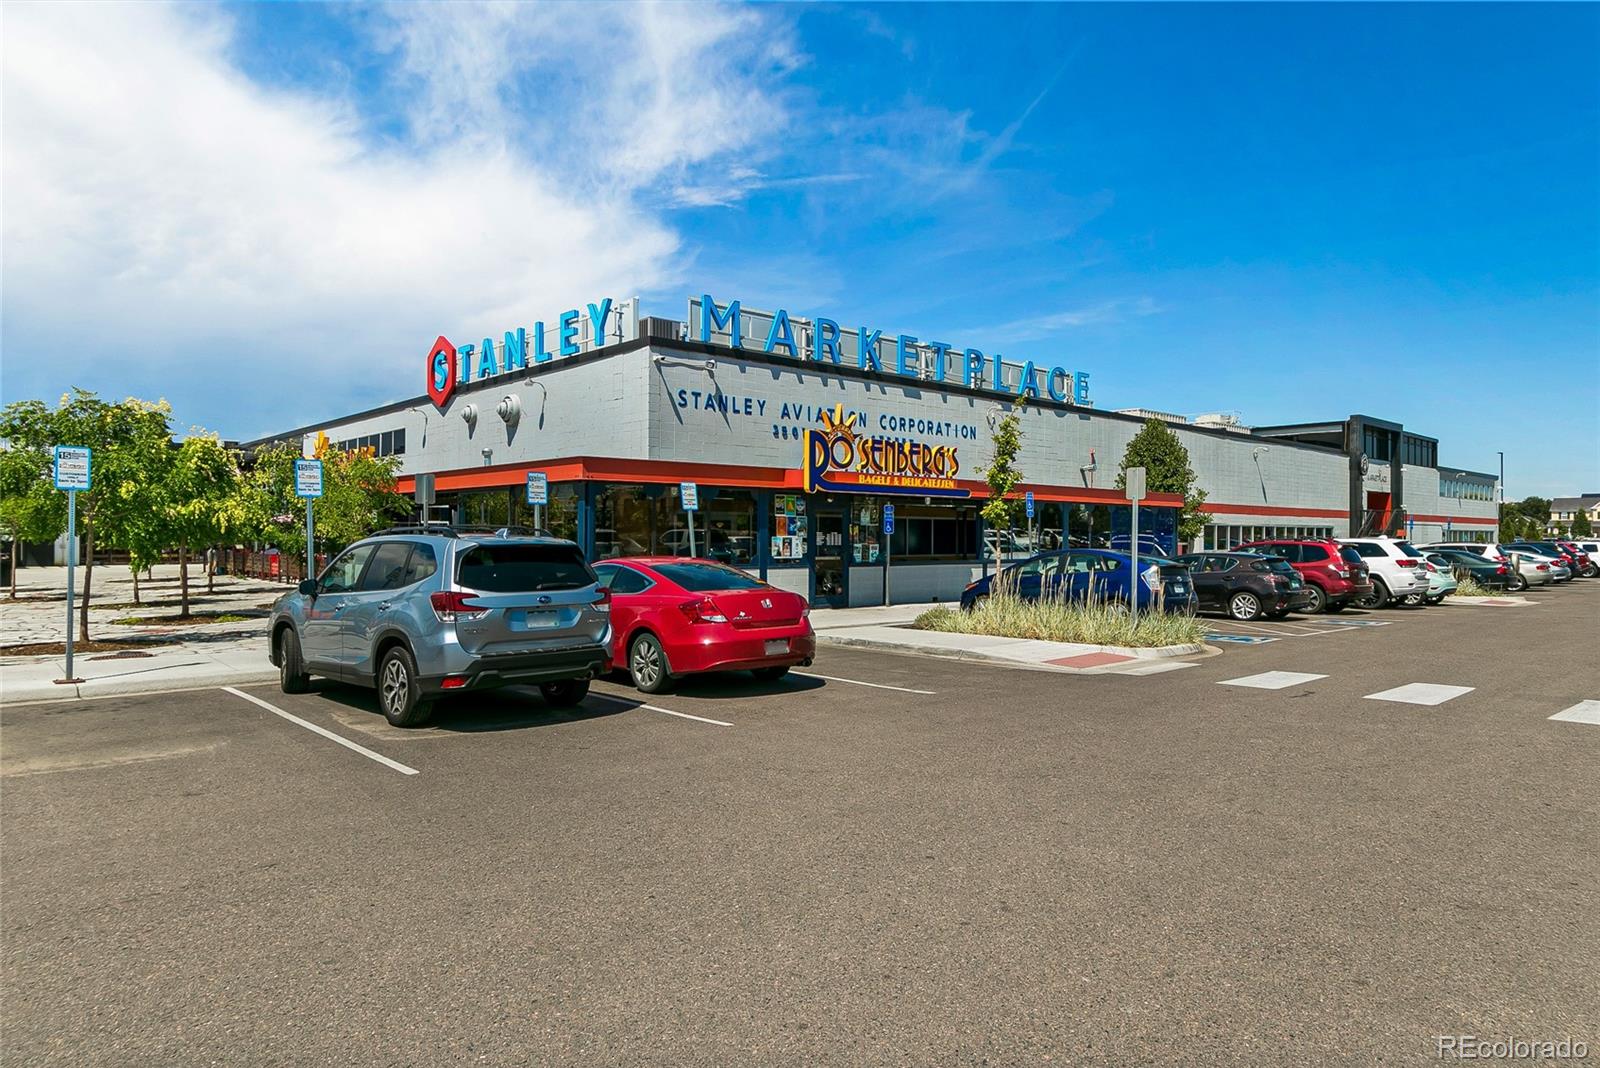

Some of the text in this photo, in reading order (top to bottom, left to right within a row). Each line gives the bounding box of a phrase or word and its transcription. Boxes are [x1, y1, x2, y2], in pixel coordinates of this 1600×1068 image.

[433, 297, 613, 391] STANLEY
[700, 294, 1091, 407] MARKETPLACE
[678, 388, 977, 440] STANLEY AVIATON CORPORATION
[802, 427, 961, 495] ROSENBERG'S
[858, 474, 956, 489] BAGELS & DELICATESSEN
